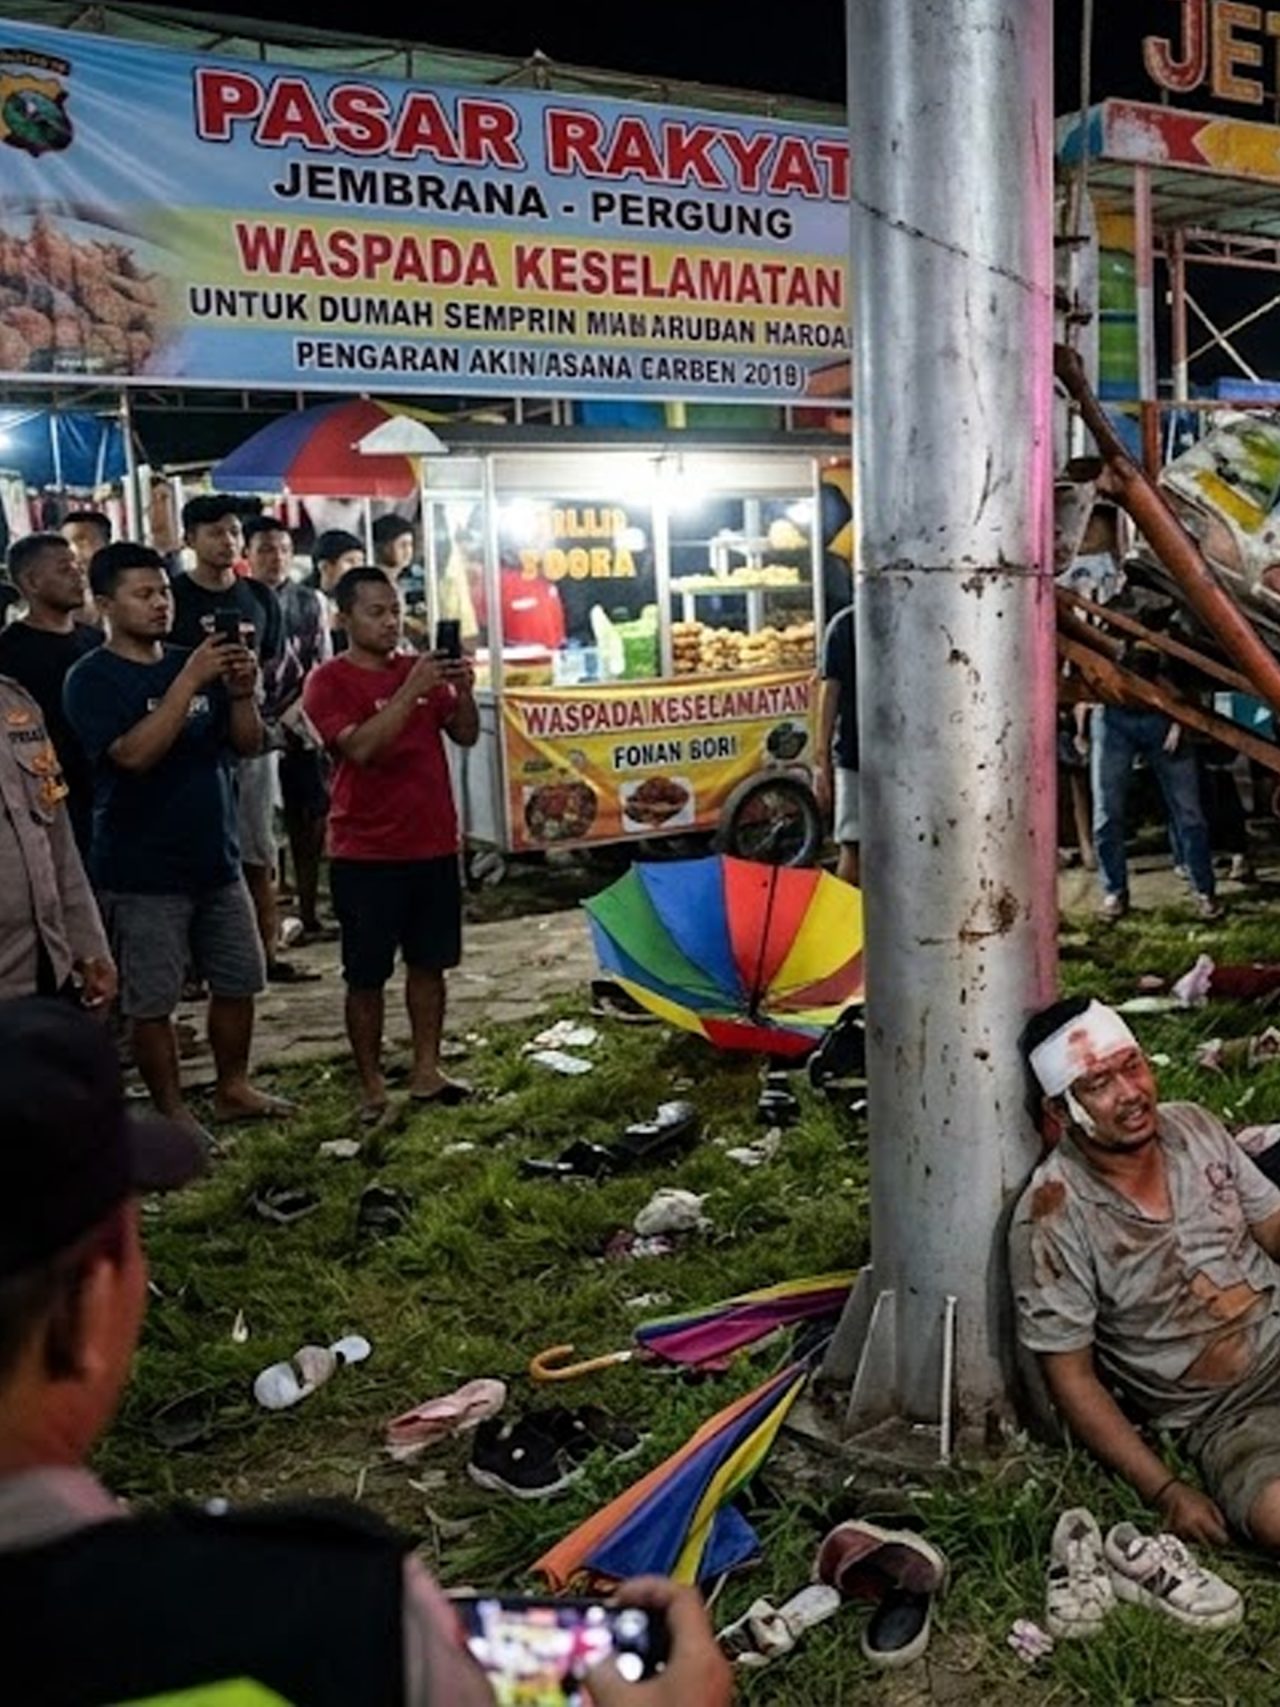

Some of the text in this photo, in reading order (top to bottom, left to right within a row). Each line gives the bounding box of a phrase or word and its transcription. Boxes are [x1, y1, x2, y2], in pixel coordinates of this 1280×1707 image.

[198, 68, 850, 203] PASAR RAKYAT
[275, 163, 547, 218] JEMBRANA
[592, 192, 791, 239] PERGUNG
[236, 223, 841, 307] WASPADA KESELAMATAN
[190, 287, 308, 321] UNTUK
[320, 296, 432, 328] DUMAH
[445, 303, 576, 335] SEMPRIN
[297, 342, 459, 373] PENGARAN
[523, 700, 643, 735] WASPADA
